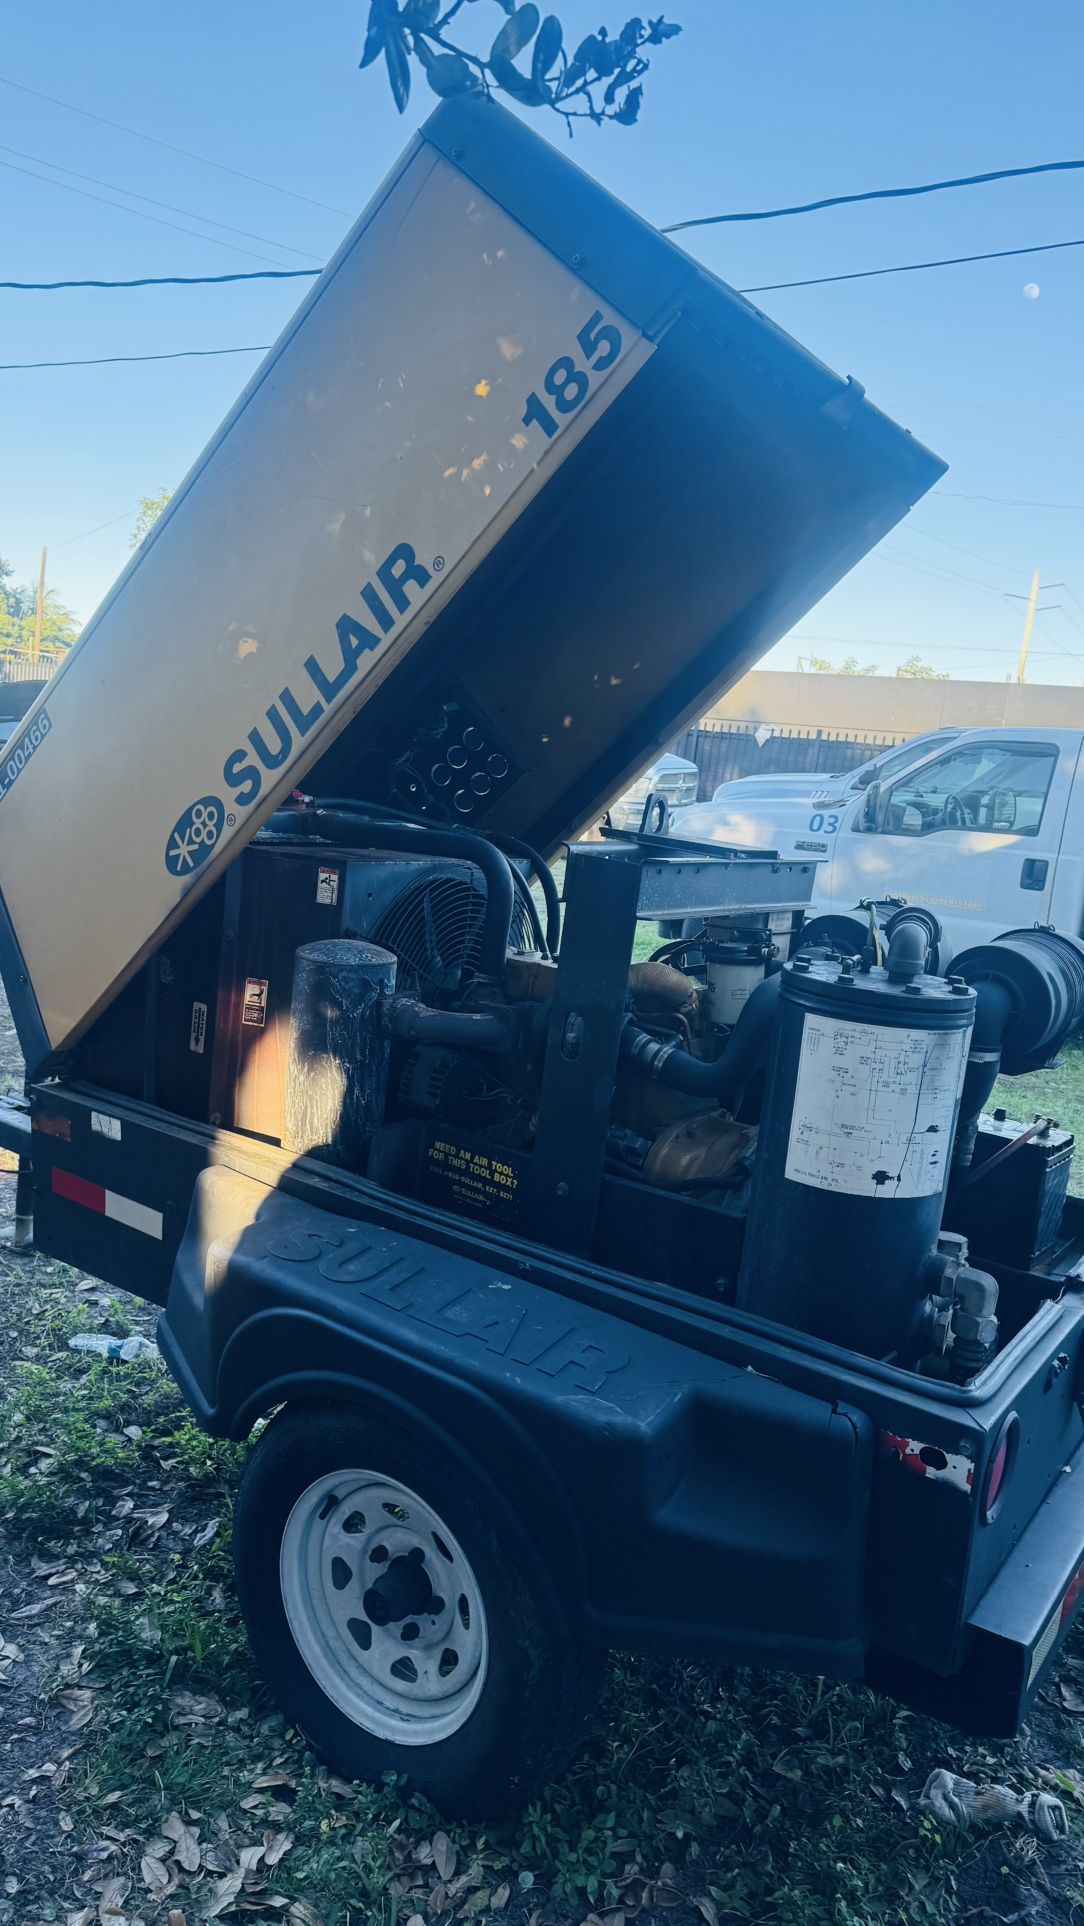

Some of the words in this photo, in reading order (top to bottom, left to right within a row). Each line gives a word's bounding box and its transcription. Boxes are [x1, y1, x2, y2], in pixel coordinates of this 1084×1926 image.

[521, 309, 623, 439] 185
[808, 813, 840, 835] 03
[429, 1149, 445, 1161] FOR
[447, 1156, 466, 1169] THIS
[469, 1163, 491, 1179] TOOL
[493, 1173, 518, 1189] BOX?
[435, 1142, 456, 1154] NEED
[459, 1150, 471, 1160] AN
[473, 1155, 488, 1167] AIR
[491, 1161, 514, 1177] TOOL
[267, 1232, 631, 1393] SULLAIR
